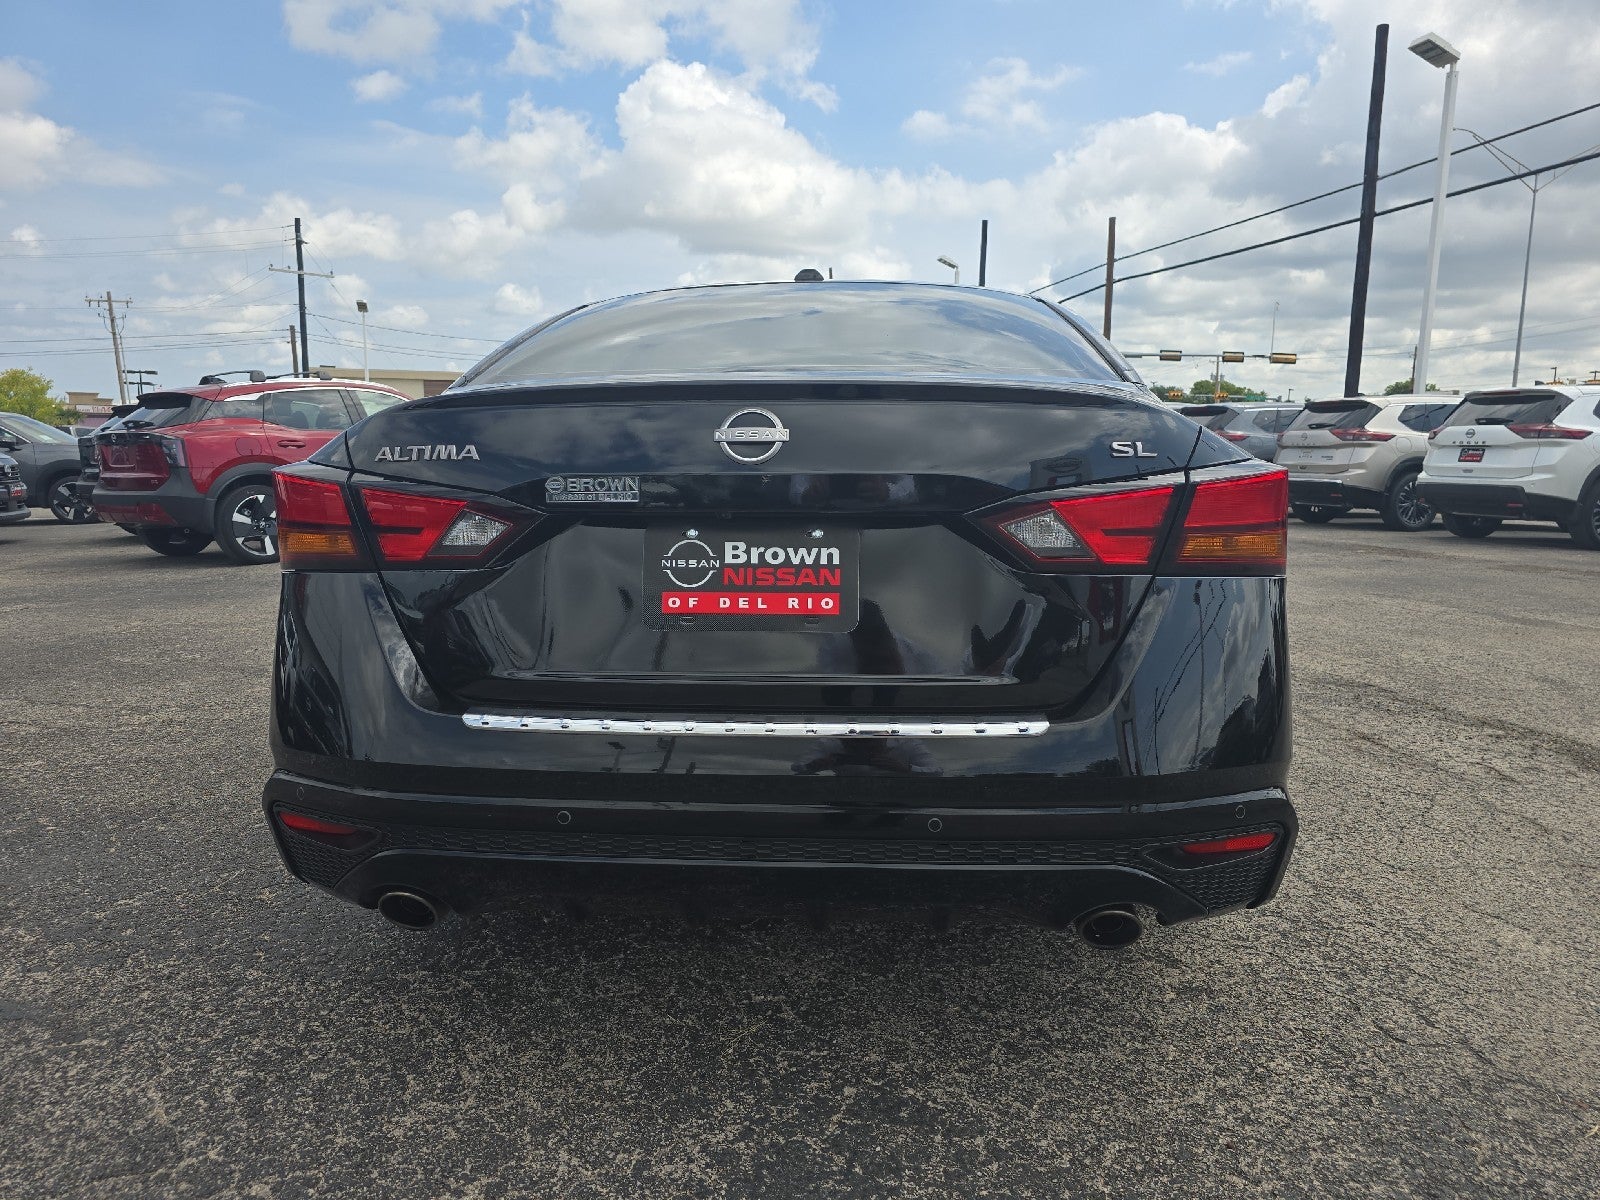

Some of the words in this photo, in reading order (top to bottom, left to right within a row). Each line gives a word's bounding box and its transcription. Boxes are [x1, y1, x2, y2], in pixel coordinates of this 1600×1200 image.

[715, 430, 787, 440] NISSAN
[374, 444, 480, 461] ALTIMA
[1111, 441, 1158, 457] SL
[567, 477, 640, 492] BROWN
[724, 541, 840, 565] Brown
[661, 559, 720, 568] NISSAN
[722, 567, 841, 586] NISSAN
[667, 597, 699, 608] OF
[719, 597, 768, 609] DEL
[787, 597, 834, 609] RIO
